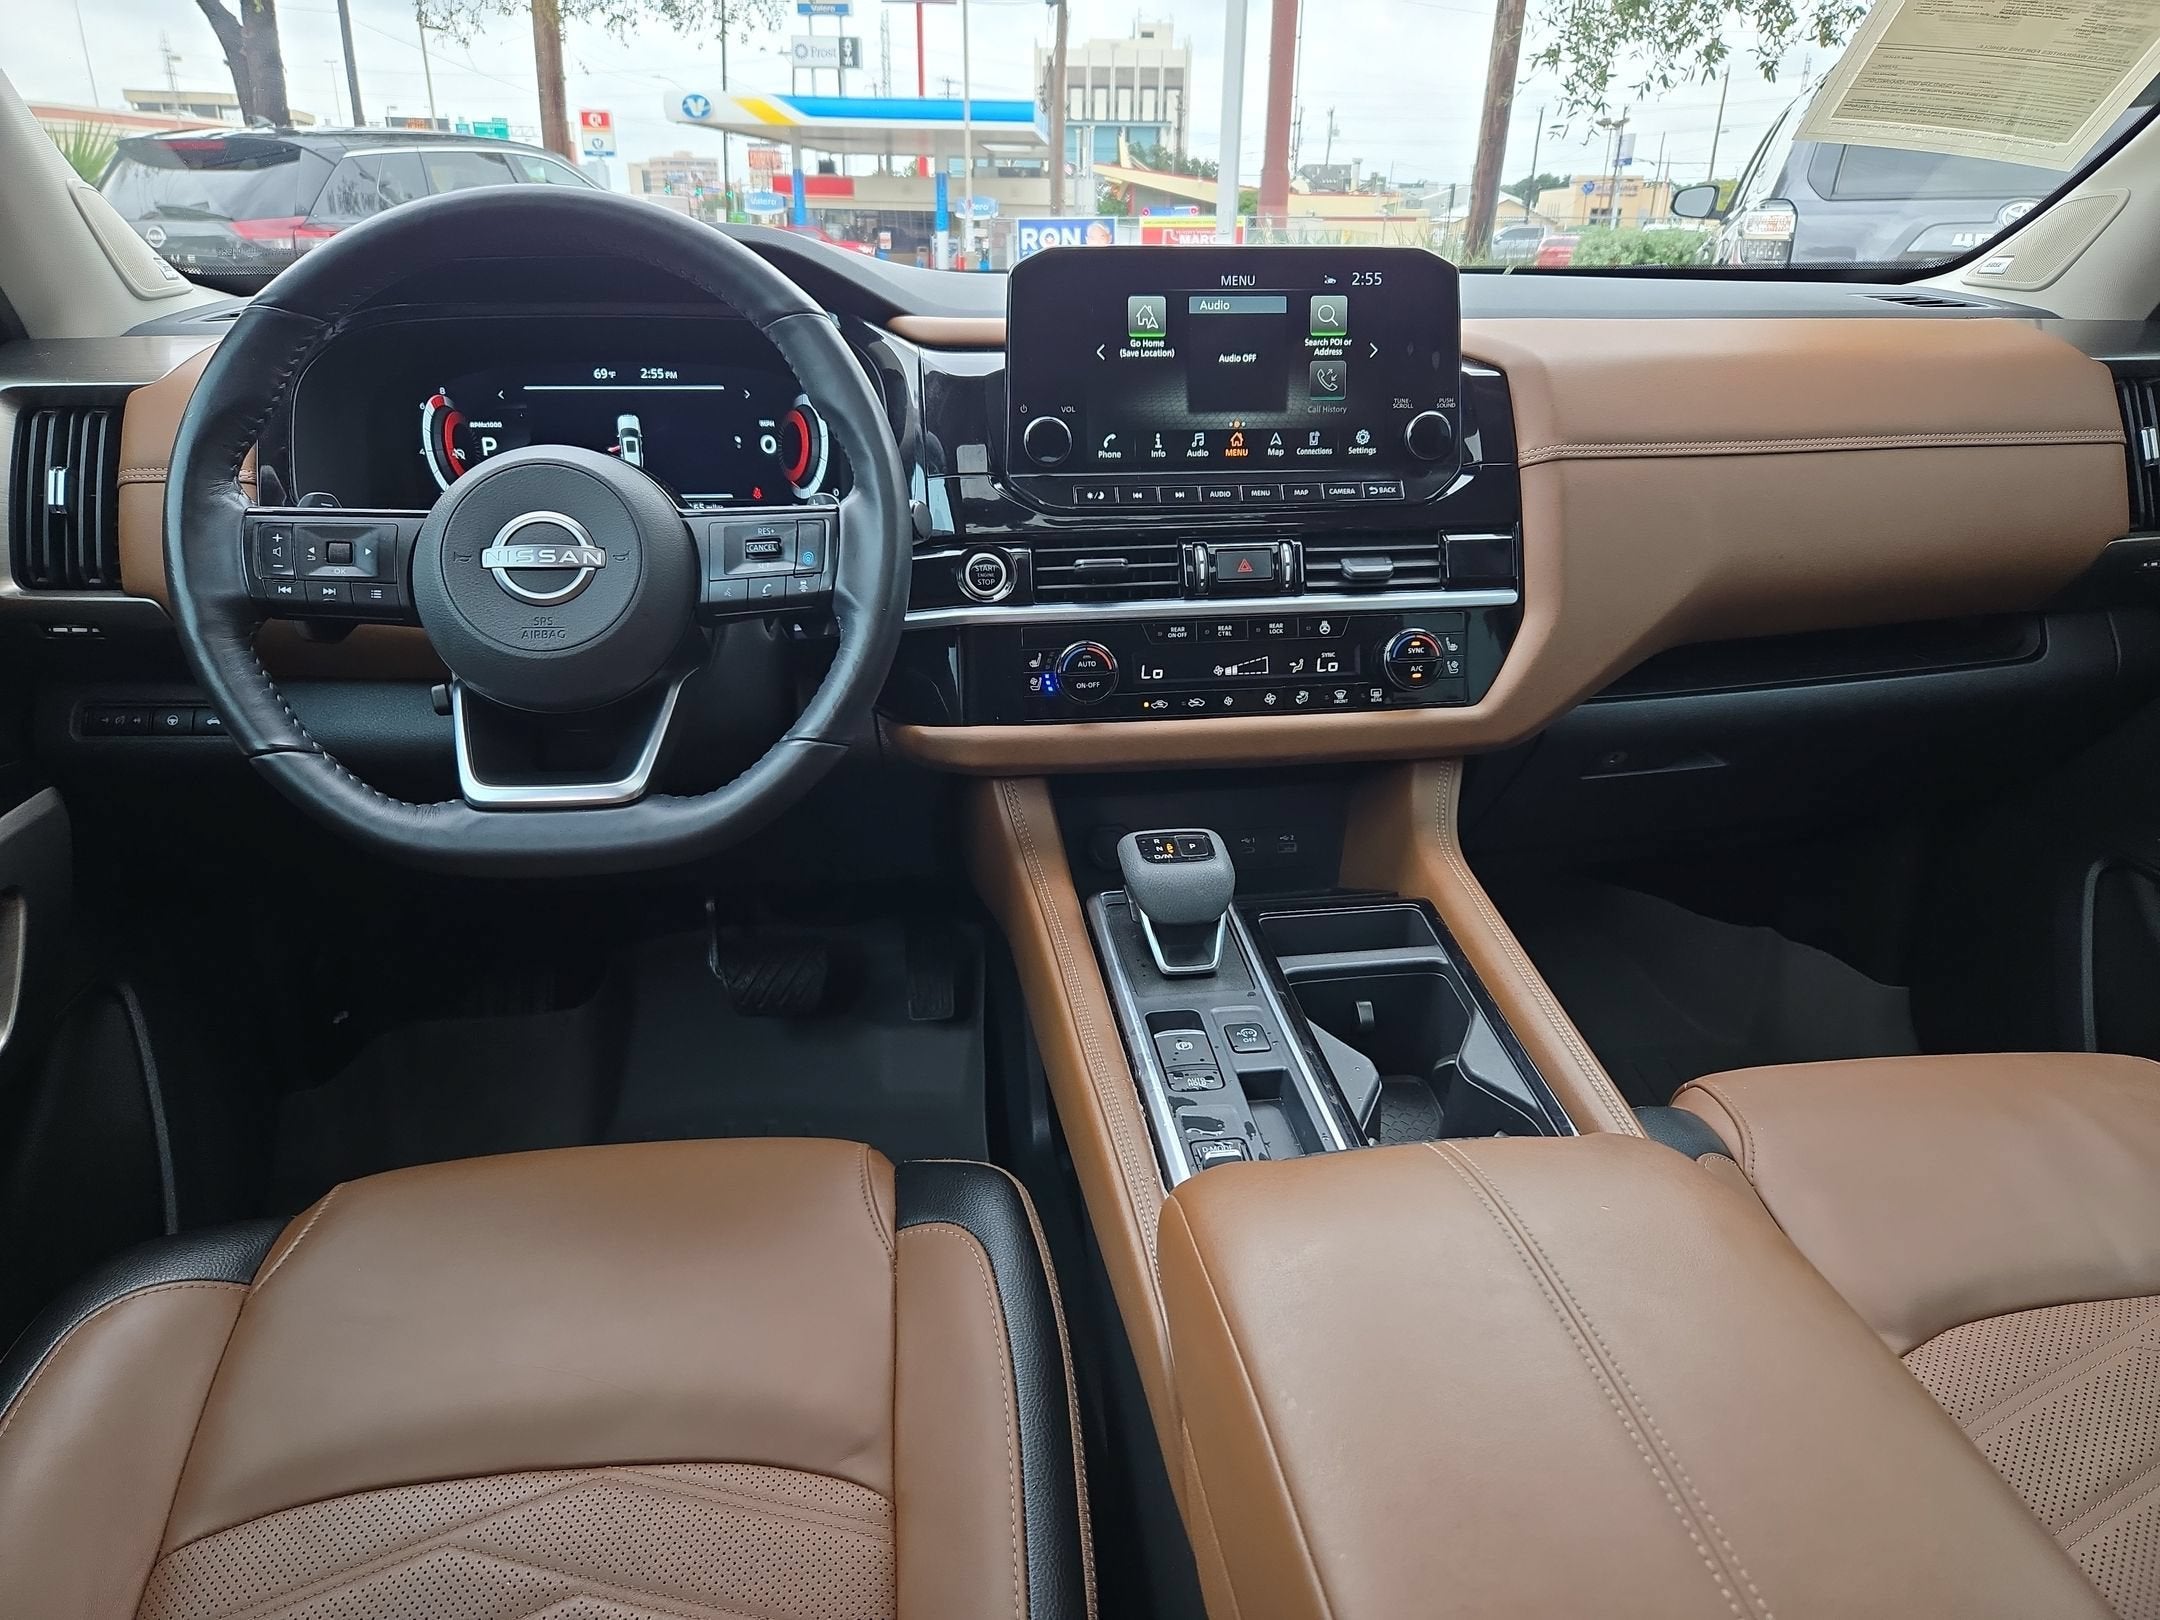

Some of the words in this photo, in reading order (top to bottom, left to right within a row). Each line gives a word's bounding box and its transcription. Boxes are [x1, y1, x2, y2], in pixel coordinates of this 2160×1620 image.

[810, 4, 837, 13] Valero
[960, 201, 989, 211] Vero
[1021, 227, 1082, 250] RON
[1220, 275, 1256, 286] MENU
[1351, 272, 1383, 286] 2:55
[1199, 300, 1230, 311] Audio
[1130, 339, 1141, 348] Go
[1142, 339, 1165, 348] Home
[1304, 338, 1329, 347] Search
[1330, 338, 1343, 347] POI
[1119, 349, 1139, 358] (Save
[1140, 349, 1175, 358] Location)
[1313, 347, 1343, 356] Address
[1218, 353, 1241, 363] Audio
[1242, 353, 1257, 363] OFF
[1307, 405, 1322, 414] Call
[1322, 405, 1347, 414] History
[481, 436, 498, 457] P
[1296, 447, 1333, 455] Connections
[1348, 446, 1377, 455] Settings
[1098, 450, 1122, 459] Phone
[1151, 450, 1166, 458] Info
[1186, 449, 1209, 457] Audio
[1225, 448, 1249, 457] MENU
[1267, 448, 1285, 458] Map
[1251, 489, 1271, 497] MENU
[1294, 488, 1309, 496] MAP
[1329, 487, 1356, 495] CAMERA
[1378, 486, 1397, 494] BACK
[748, 544, 777, 552] CANCEL
[485, 549, 602, 565] NISSAN
[975, 564, 997, 572] START
[533, 616, 554, 626] SRS
[521, 629, 566, 639] AIRBAG
